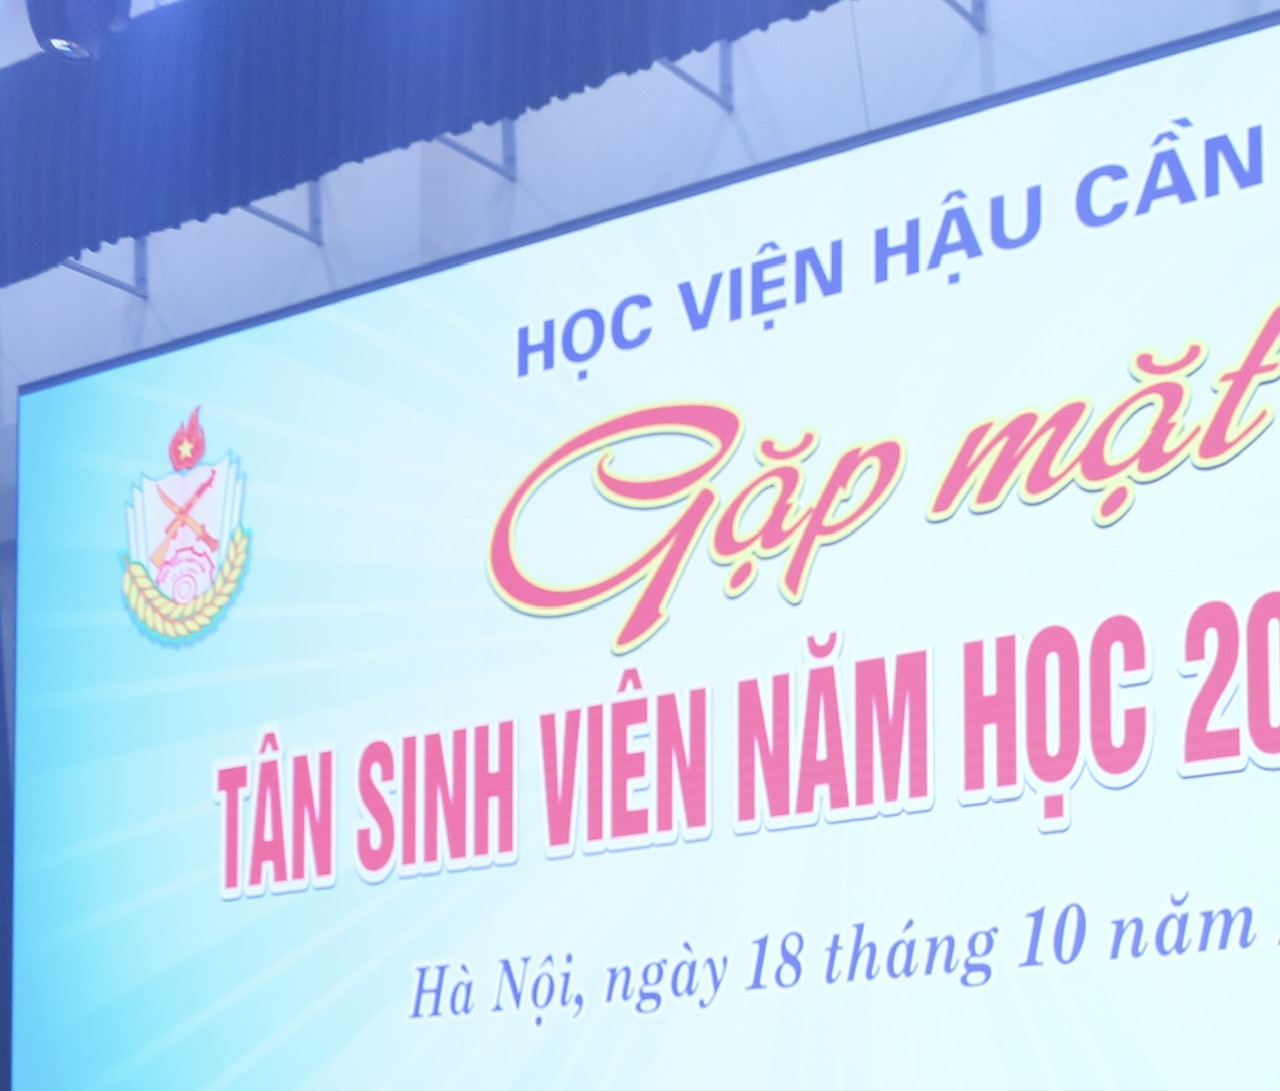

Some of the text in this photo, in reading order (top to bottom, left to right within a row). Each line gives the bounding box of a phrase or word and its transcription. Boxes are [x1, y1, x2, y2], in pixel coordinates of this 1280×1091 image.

[515, 117, 1264, 381] HỌC VIỆN HẬU CẦN
[489, 401, 906, 652] Gặp
[216, 731, 334, 891] TÂN
[355, 719, 516, 874] SINH
[539, 666, 709, 849] VIÊN
[736, 630, 930, 823] NĂM
[962, 613, 1148, 820] HỌC
[408, 962, 475, 1020] Hà
[490, 953, 586, 1027] Nội,
[604, 941, 729, 1015] ngày
[744, 931, 805, 991] 18
[824, 918, 999, 988] tháng
[1017, 902, 1087, 968] 10
[1108, 890, 1258, 960] năm
